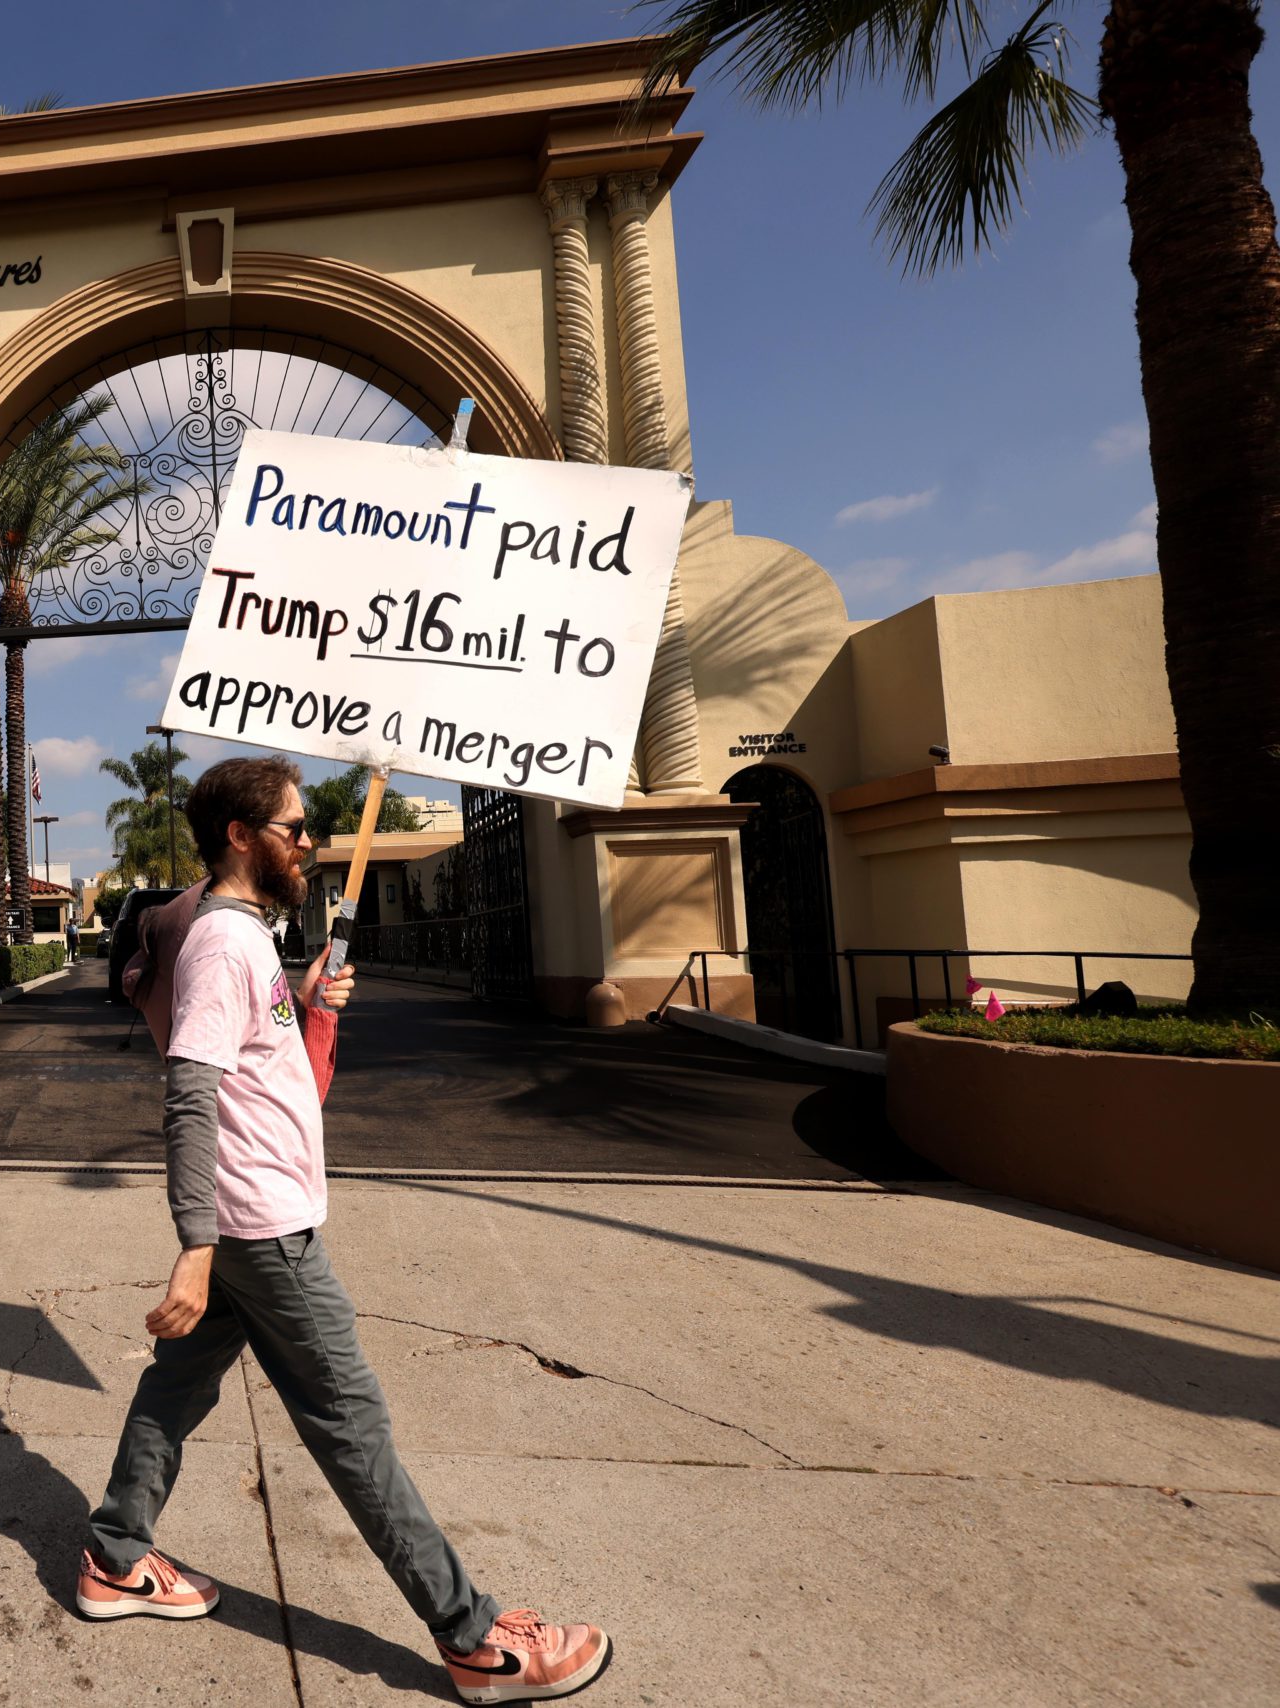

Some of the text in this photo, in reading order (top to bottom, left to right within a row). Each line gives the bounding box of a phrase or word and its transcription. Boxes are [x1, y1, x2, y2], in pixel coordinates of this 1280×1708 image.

[246, 464, 635, 580] Paramount paid
[212, 567, 349, 661] Trump
[545, 618, 615, 678] to
[179, 670, 613, 788] approve a merger
[728, 743, 807, 757] ENTRANCE
[739, 732, 795, 745] VISITOR
